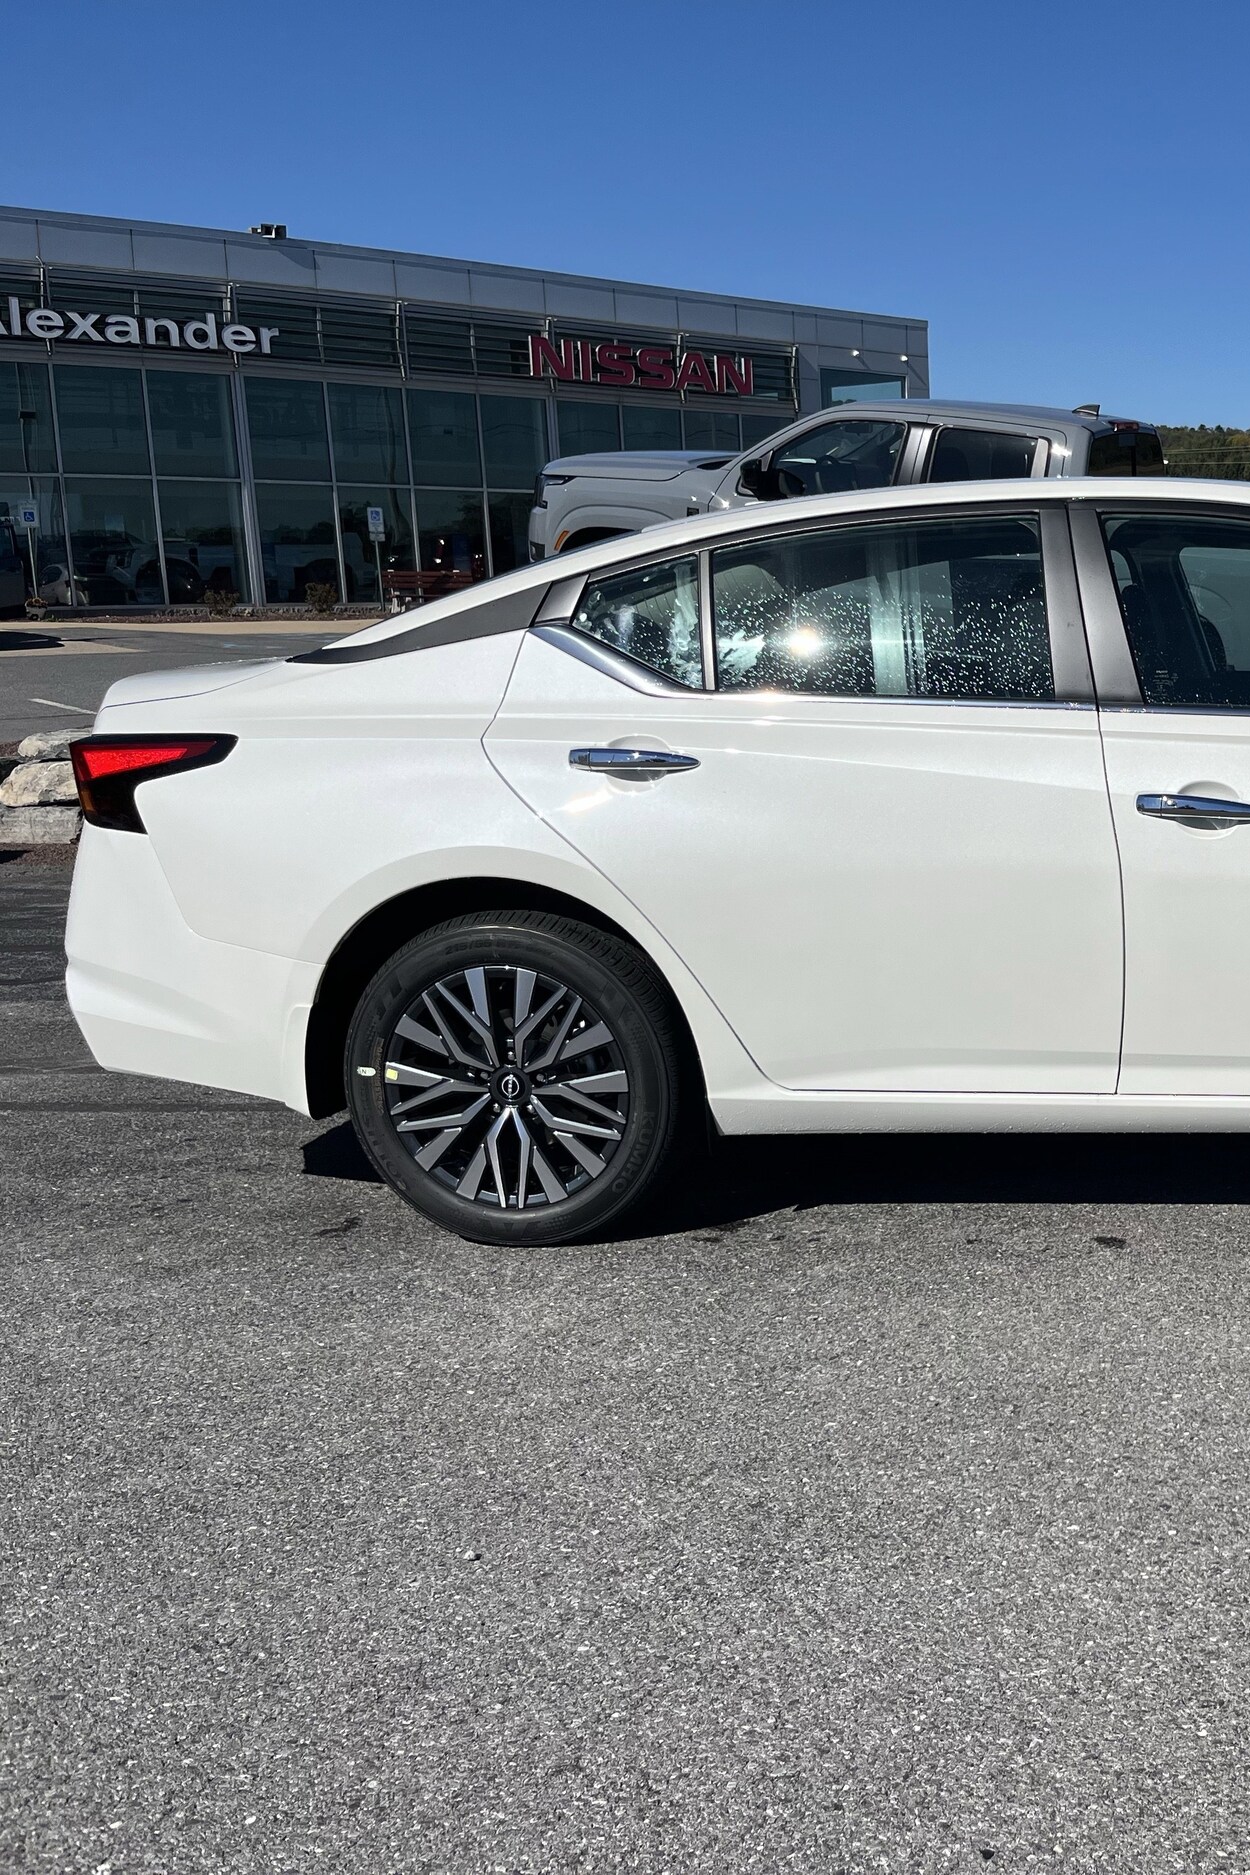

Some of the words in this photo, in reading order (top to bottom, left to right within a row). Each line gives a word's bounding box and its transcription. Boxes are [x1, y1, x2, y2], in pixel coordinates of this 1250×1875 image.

[0, 296, 279, 354] lexander
[528, 335, 753, 396] NISSAN
[612, 1111, 656, 1193] KUMHO
